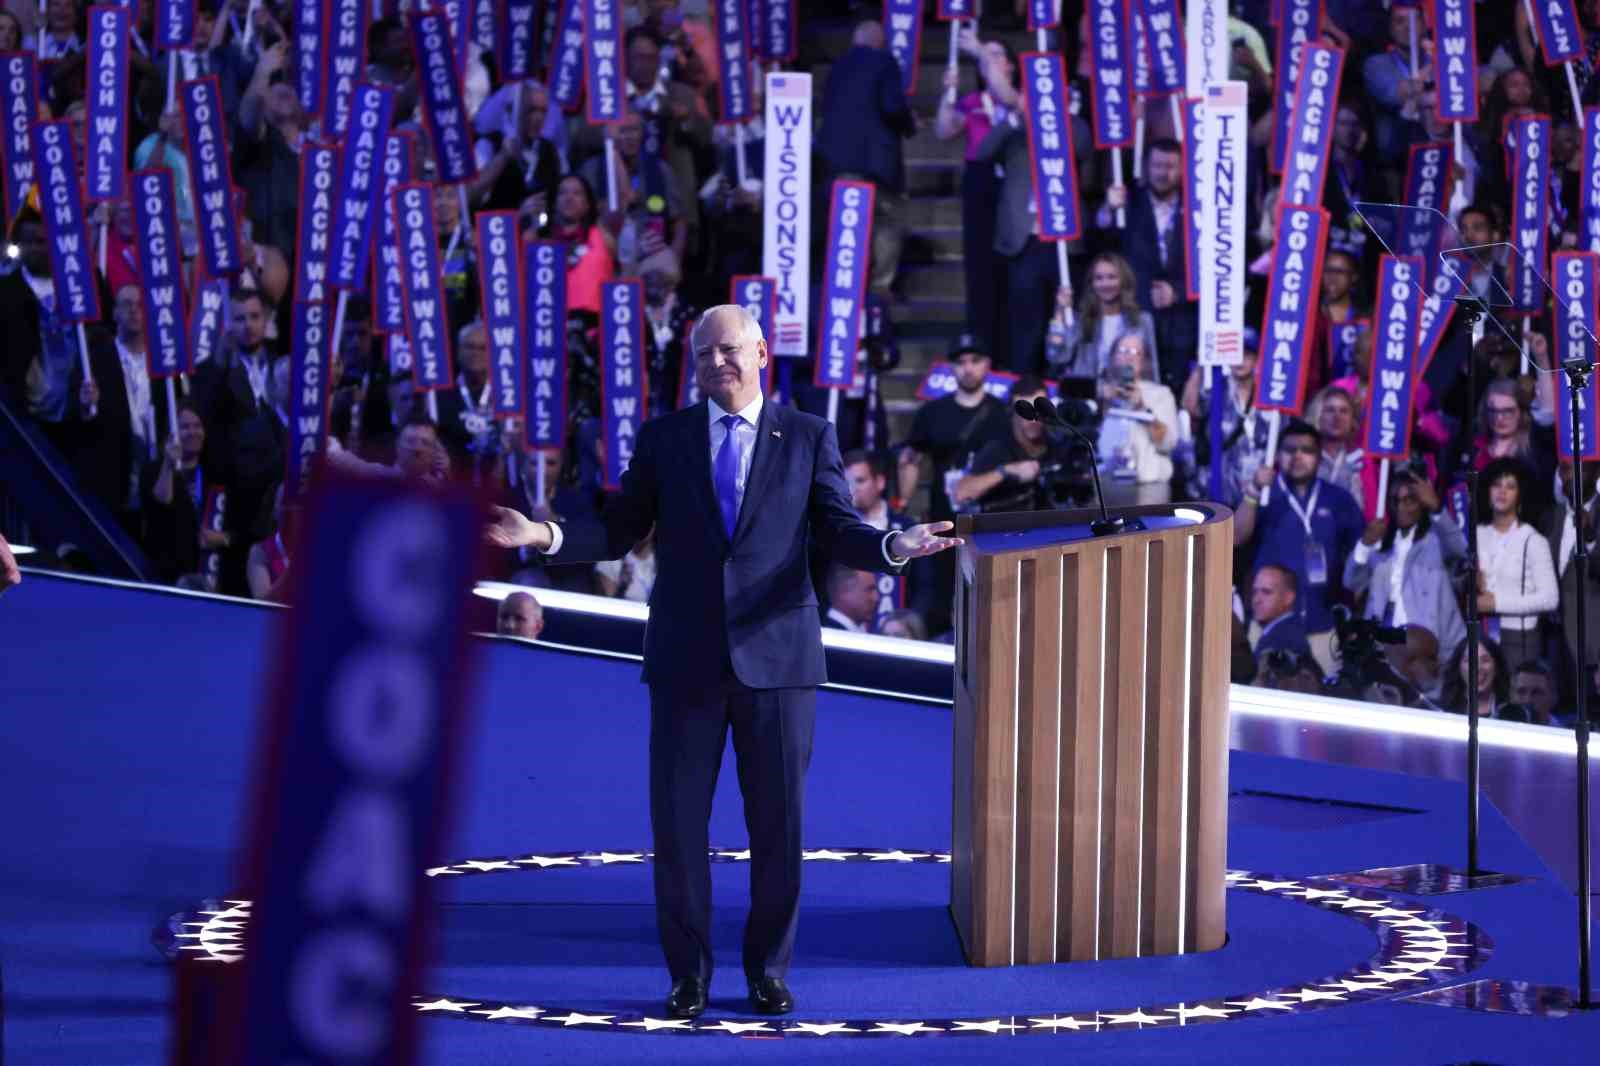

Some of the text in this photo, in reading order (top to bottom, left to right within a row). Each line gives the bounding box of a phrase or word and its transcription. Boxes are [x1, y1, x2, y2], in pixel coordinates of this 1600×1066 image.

[168, 0, 182, 40] LZ
[334, 57, 357, 132] WALZ
[592, 40, 616, 115] WALZ
[768, 0, 786, 54] ALZ
[1098, 0, 1123, 140] ACH WALZ
[1150, 12, 1178, 86] WALZ
[1443, 37, 1465, 112] WALZ
[1548, 0, 1570, 53] ALZ
[9, 57, 30, 152] COACH
[95, 11, 118, 193] COACH WALZ
[421, 16, 465, 176] COACH WALZ
[1034, 57, 1067, 232] COACH WALZ
[1301, 49, 1332, 144] COACH
[1525, 121, 1541, 219] COACH
[43, 124, 85, 313] COACH WALZ
[192, 84, 230, 268] COACH WALZ
[306, 150, 332, 300] COACH WA
[338, 89, 382, 279] COACH WALZ
[774, 105, 804, 315] WISCONSIN
[1214, 114, 1236, 323] TENNESSEE
[1414, 149, 1441, 225] COACH
[143, 175, 177, 366] COACH WALZ
[382, 246, 401, 324] WALZ
[404, 189, 438, 380] COACH WALZ
[488, 215, 515, 408] COACH WALZ
[531, 245, 556, 440] COACH WALZ
[612, 284, 632, 387] COACH
[829, 187, 860, 378] COACH WALZ
[1269, 211, 1311, 400] COACH WALZ
[1567, 258, 1585, 358] COACH
[303, 305, 322, 405] COACH
[1378, 261, 1412, 450] COACH WALZ
[292, 501, 452, 1060] COAC
